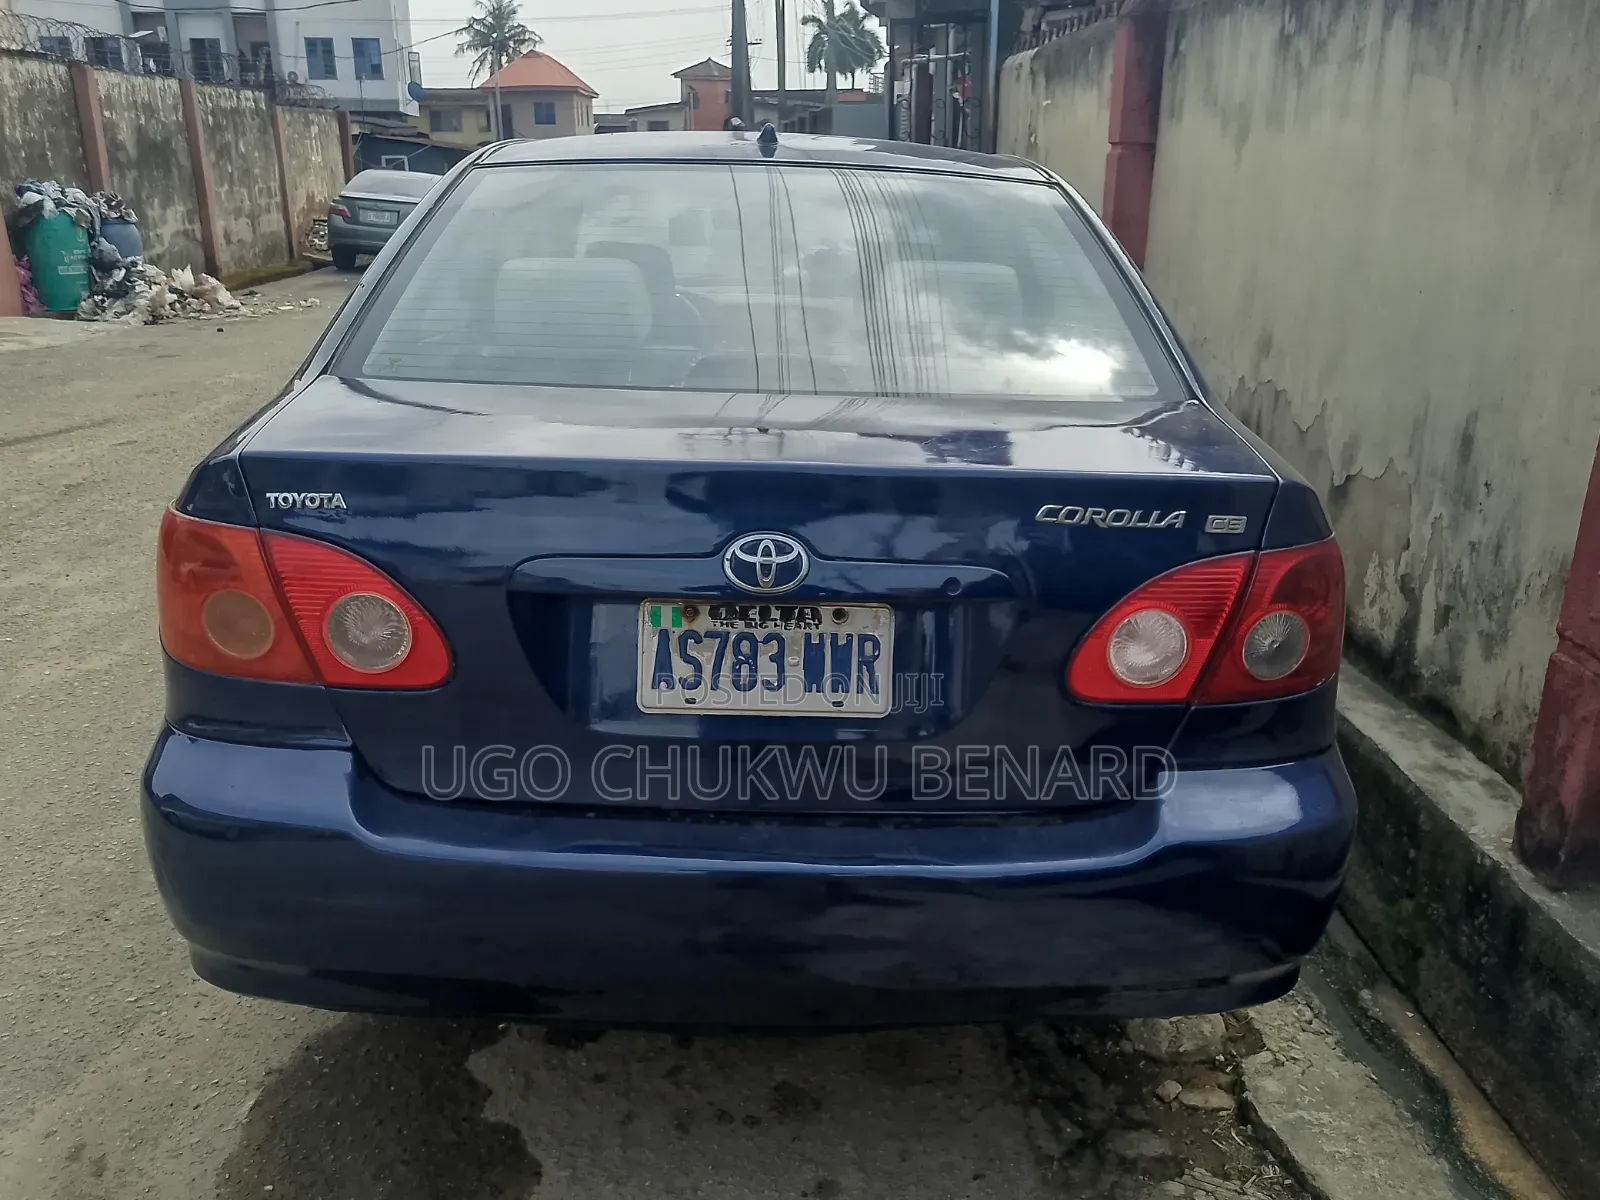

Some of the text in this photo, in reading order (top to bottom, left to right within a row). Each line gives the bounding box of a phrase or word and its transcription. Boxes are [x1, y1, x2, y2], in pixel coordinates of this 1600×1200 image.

[266, 492, 347, 509] TOYOTA
[1034, 505, 1187, 529] COROLLA
[711, 620, 739, 629] THE
[774, 620, 820, 631] HEART
